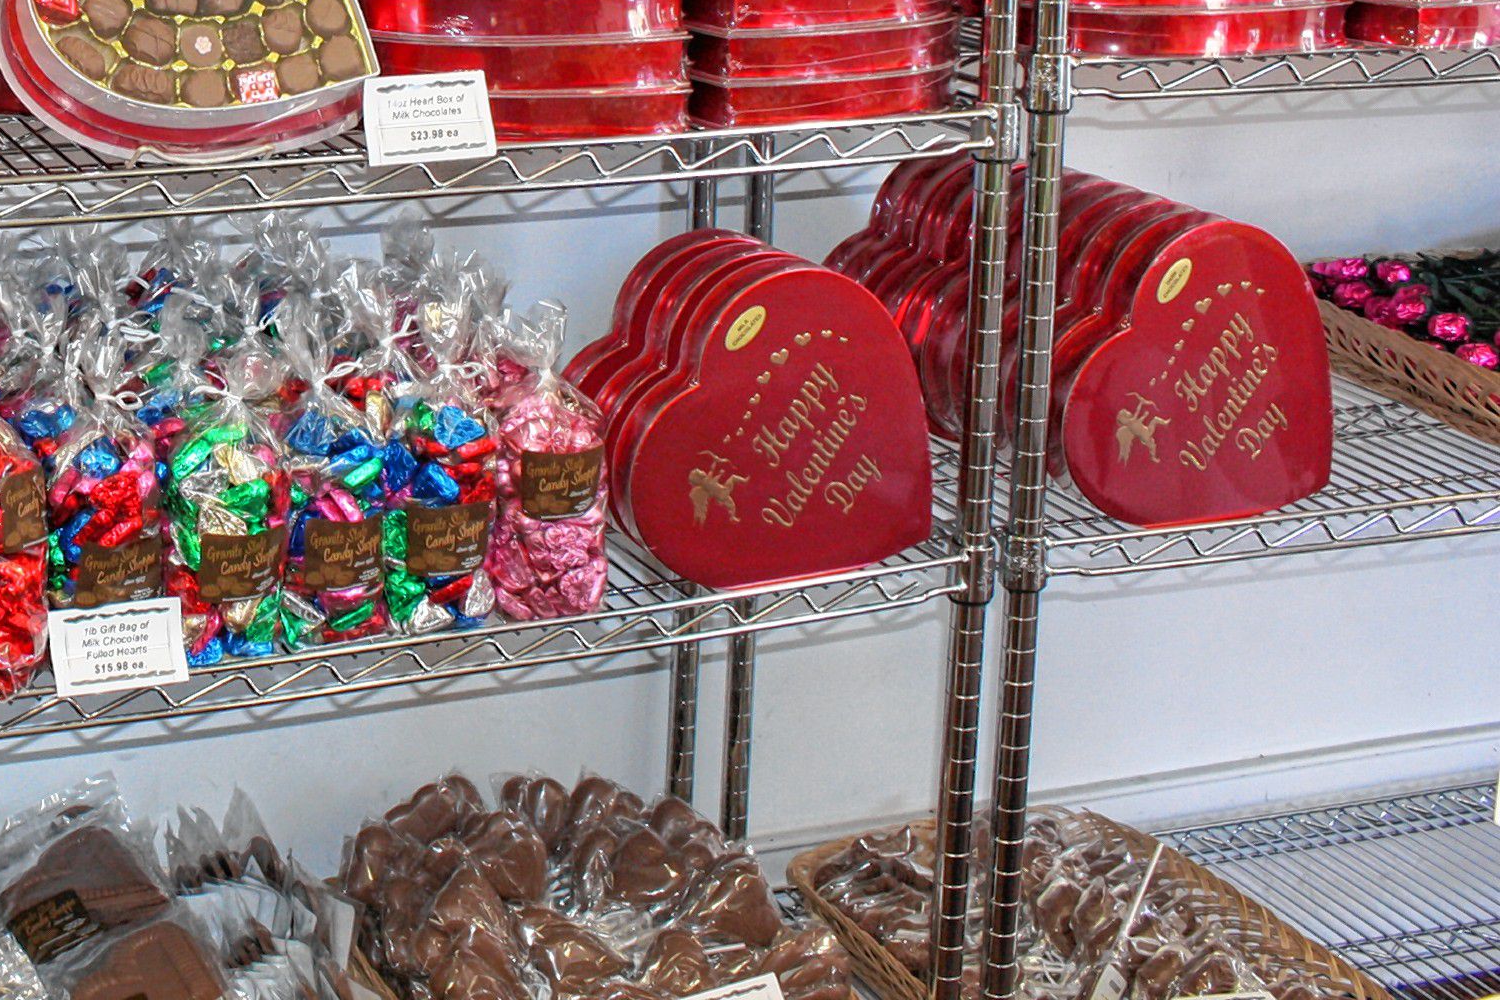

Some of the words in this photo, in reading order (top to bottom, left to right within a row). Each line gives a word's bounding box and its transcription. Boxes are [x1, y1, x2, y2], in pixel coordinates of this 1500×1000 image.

[409, 97, 434, 107] Heart
[436, 95, 453, 105] Box
[455, 93, 465, 103] of
[392, 110, 410, 121] Milk
[412, 107, 462, 119] Chocolates
[410, 129, 444, 142] $23.98
[1174, 311, 1255, 413] Happy
[752, 361, 840, 468] Happy
[1235, 402, 1289, 461] Day
[538, 471, 570, 497] Candy
[824, 453, 883, 515] Day
[425, 529, 456, 552] Candy
[220, 553, 252, 578] Candy
[323, 542, 354, 567] Candy
[84, 626, 98, 637] 1lb
[99, 624, 117, 635] Gift
[118, 622, 138, 633] Bag
[140, 620, 151, 630] of
[81, 638, 101, 649] Milk
[102, 634, 150, 647] Chocolate
[116, 645, 148, 657] Hearts
[94, 660, 129, 675] $15.98
